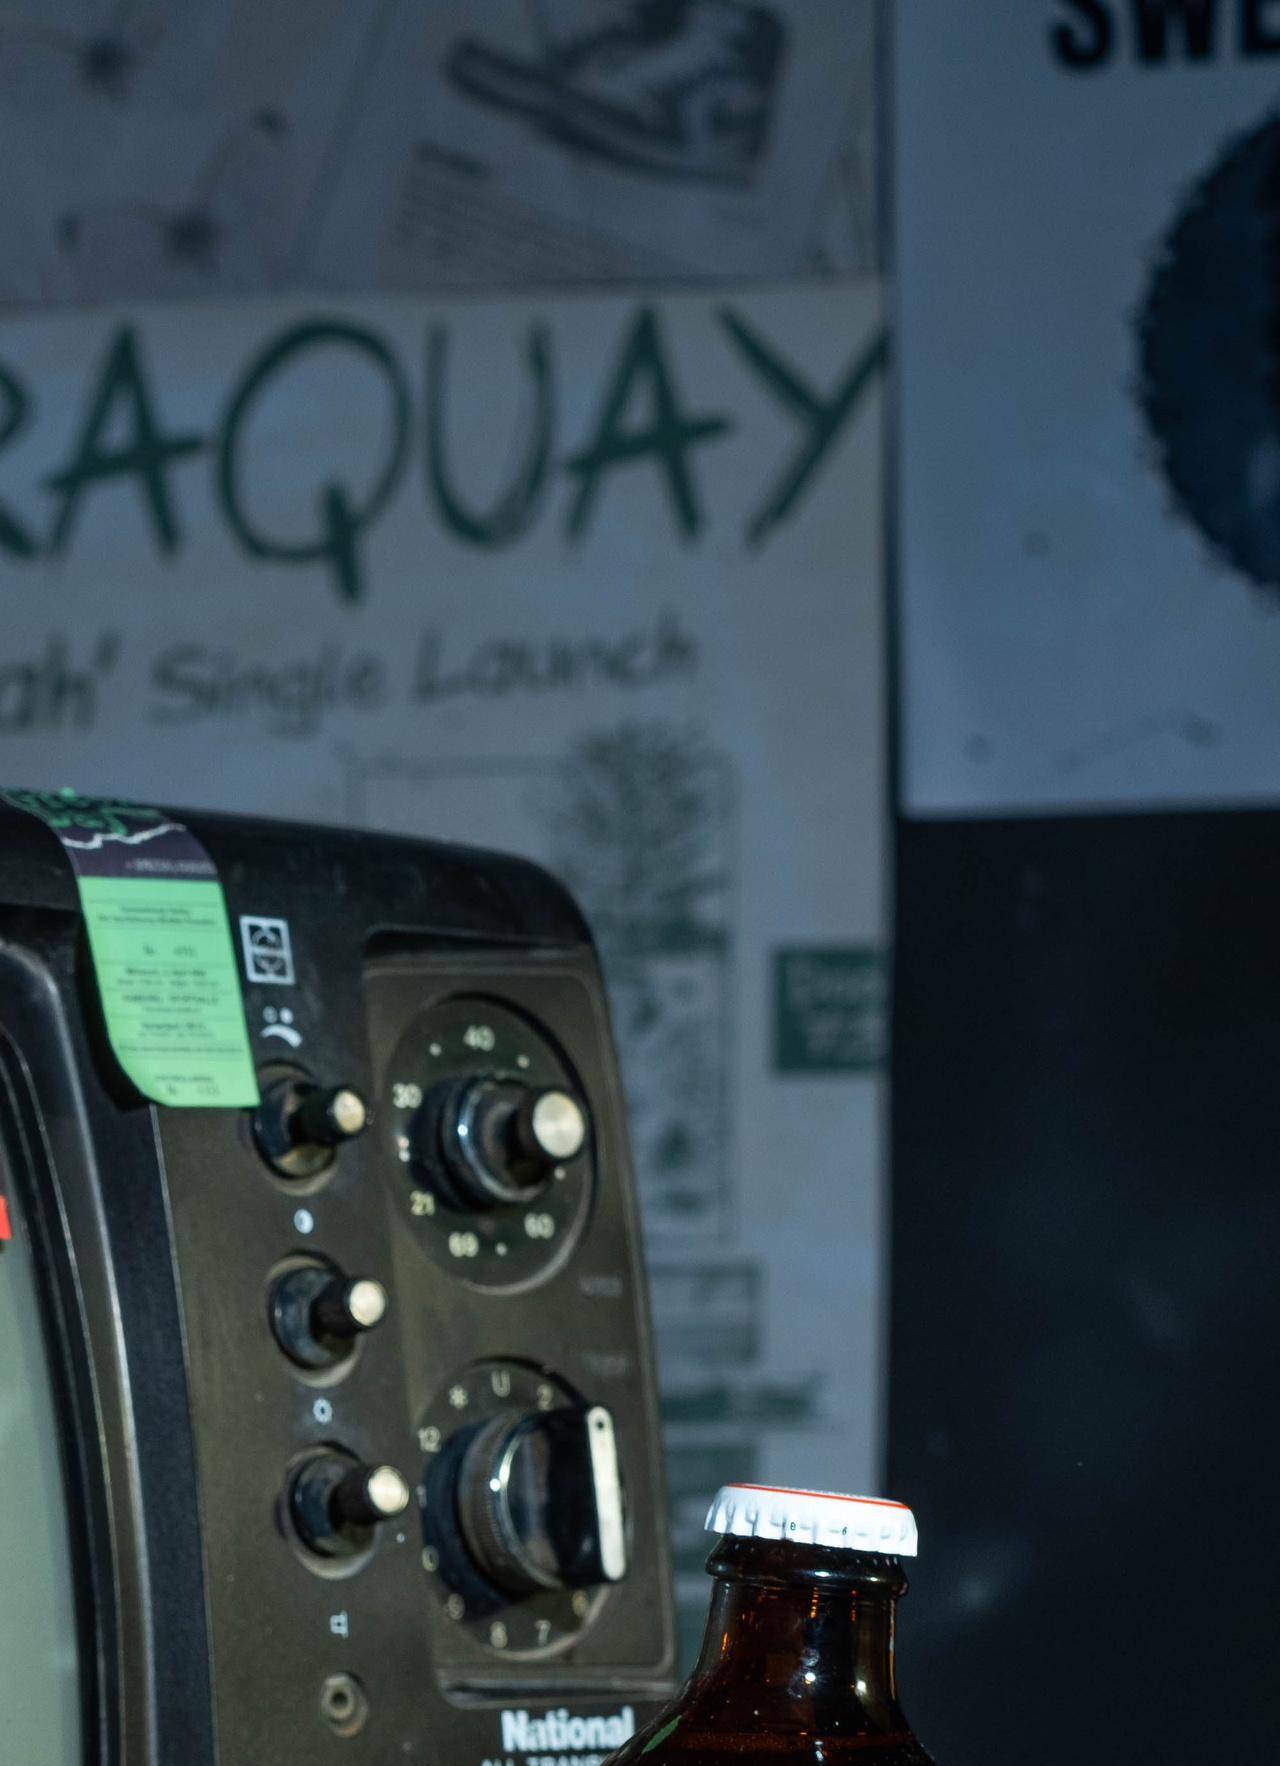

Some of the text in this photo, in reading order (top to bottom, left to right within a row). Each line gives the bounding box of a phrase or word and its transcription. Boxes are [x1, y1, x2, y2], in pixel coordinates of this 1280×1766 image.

[148, 638, 388, 741] Single
[408, 608, 700, 706] Launch
[464, 1025, 495, 1051] 40
[393, 1083, 422, 1108] 30
[524, 1213, 555, 1239] 60
[491, 1369, 510, 1397] U
[535, 1619, 552, 1645] 7
[501, 1706, 634, 1752] National
